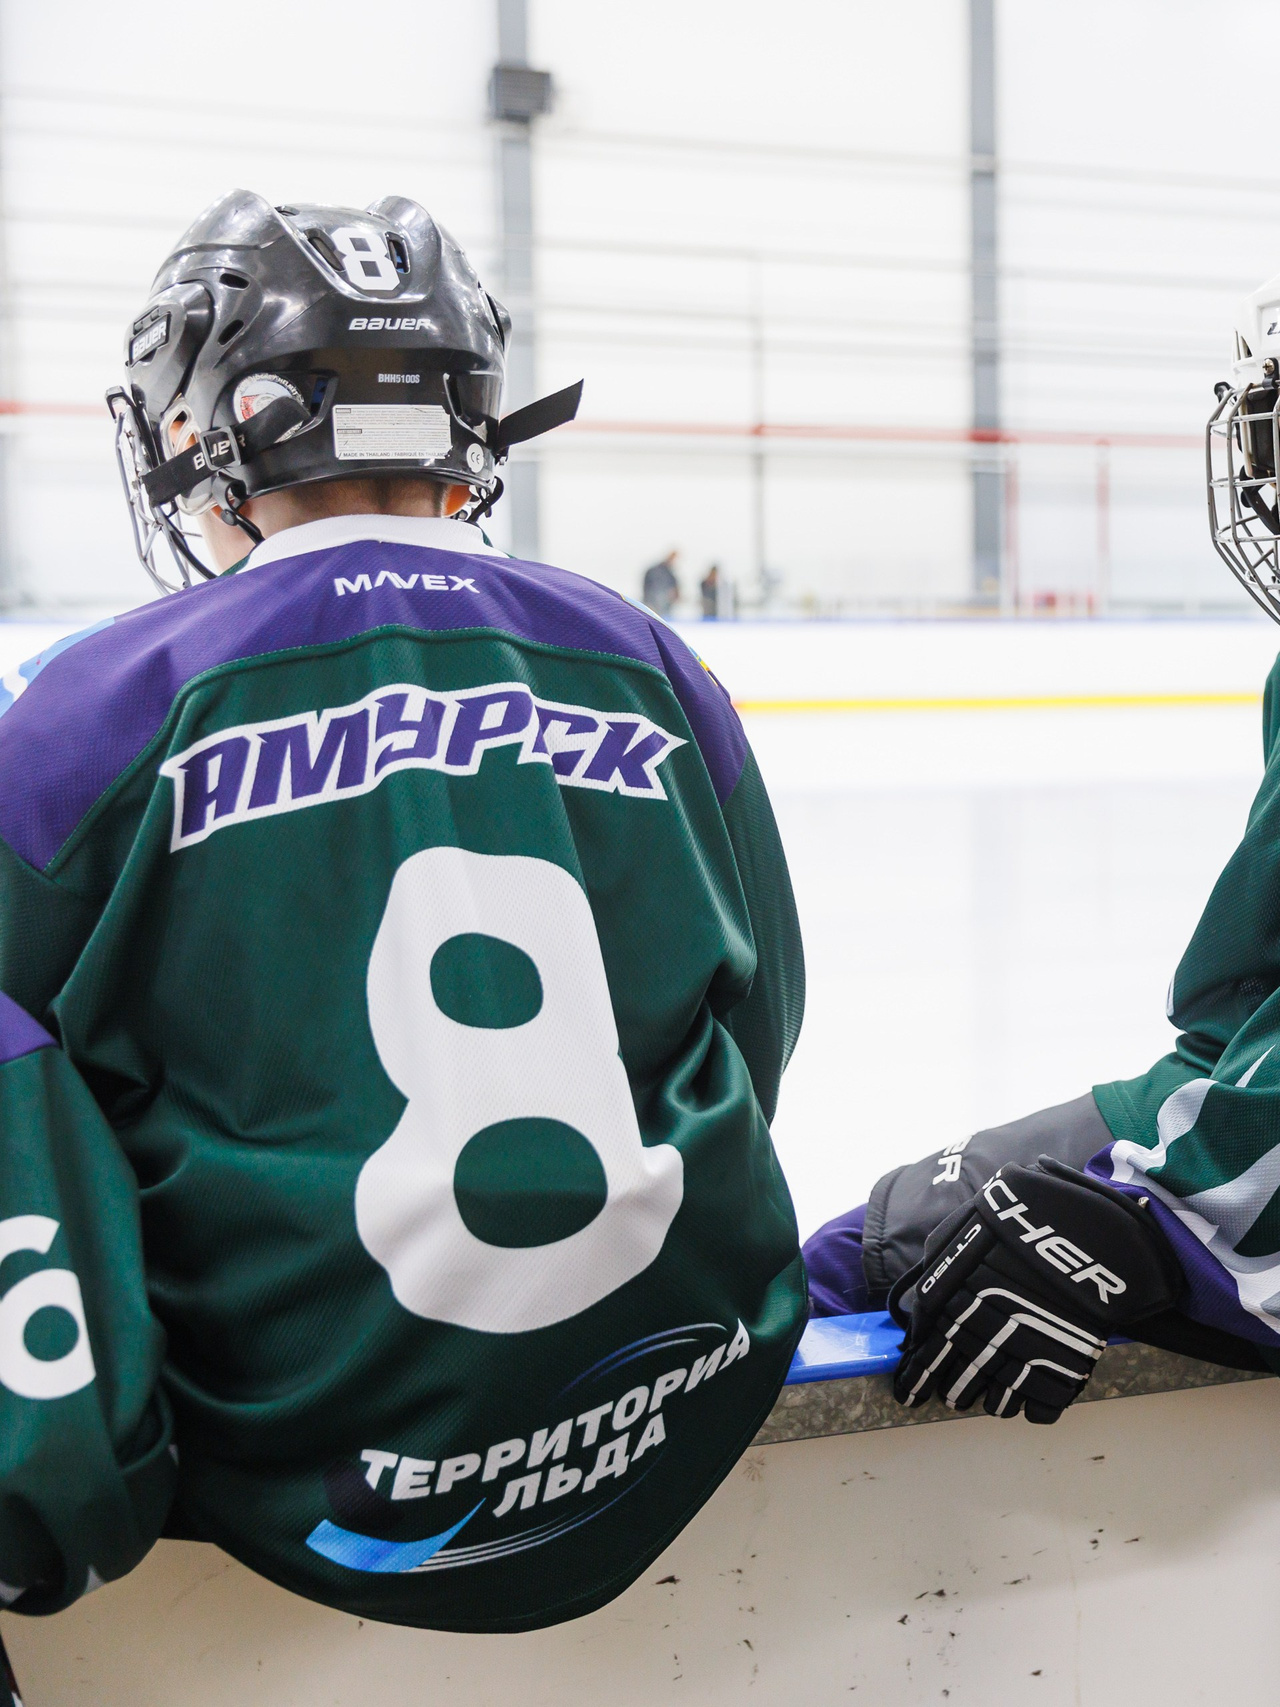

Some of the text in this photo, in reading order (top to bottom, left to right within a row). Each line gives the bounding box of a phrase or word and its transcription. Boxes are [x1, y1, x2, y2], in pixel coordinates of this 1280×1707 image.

[330, 227, 401, 291] 8
[131, 320, 167, 361] BAUER
[348, 317, 438, 334] BAUER
[334, 570, 480, 597] MAVEX
[160, 684, 689, 853] АМУРСК
[355, 846, 684, 1333] 8
[982, 1169, 1127, 1304] CHER
[361, 1317, 751, 1501] ТЕРРИТОРИЯ
[492, 1412, 667, 1518] ЛЬДА
